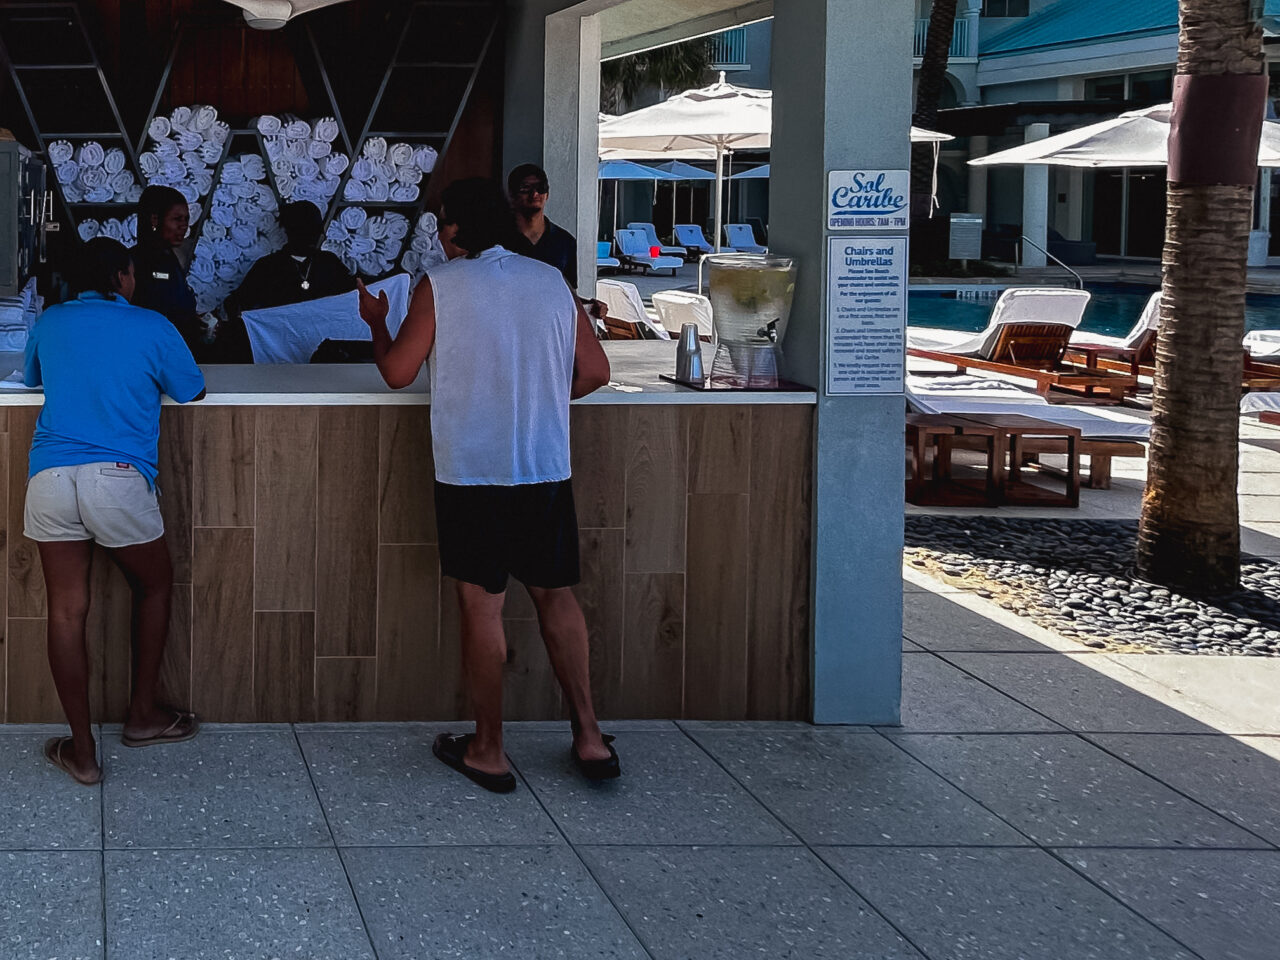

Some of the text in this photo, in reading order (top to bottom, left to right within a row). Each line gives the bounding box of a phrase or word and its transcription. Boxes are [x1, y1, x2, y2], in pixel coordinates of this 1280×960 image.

[850, 172, 885, 194] Sol
[831, 186, 904, 209] Caribe
[844, 246, 893, 256] Chairs and
[845, 257, 893, 266] Umbrellas
